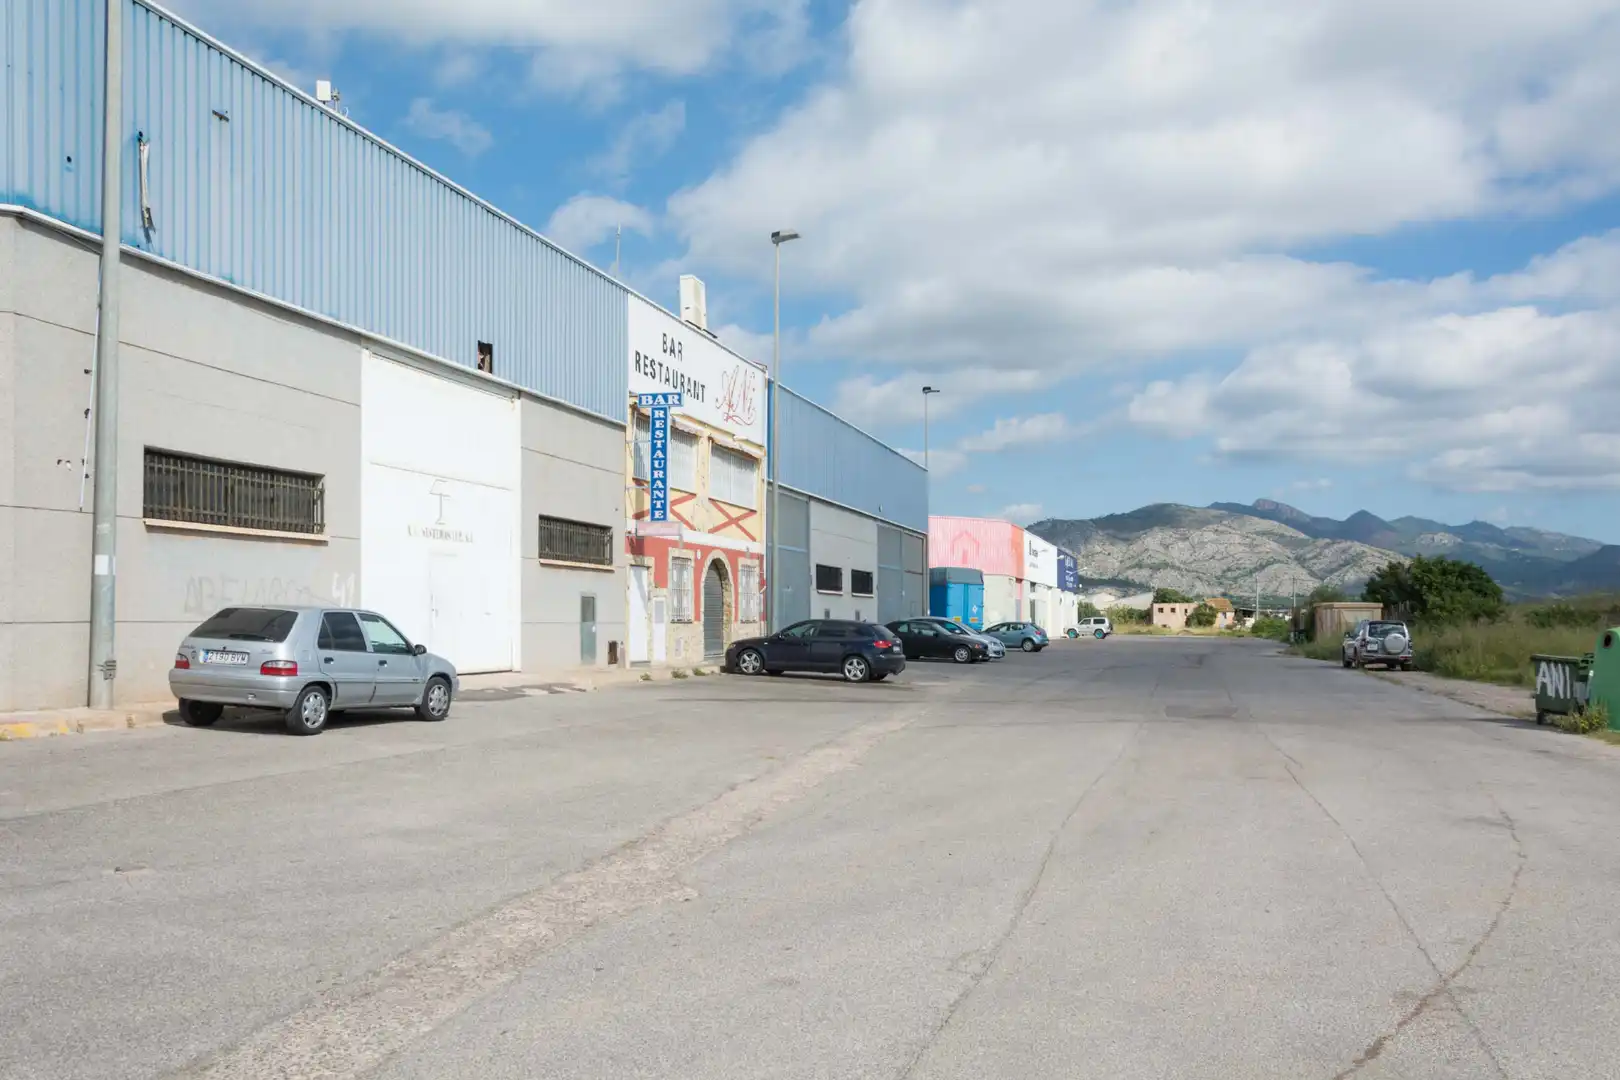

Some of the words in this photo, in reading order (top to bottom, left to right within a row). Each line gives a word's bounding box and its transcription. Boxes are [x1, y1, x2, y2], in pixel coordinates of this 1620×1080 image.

[662, 332, 684, 362] BAR
[634, 350, 706, 404] RESTAURANT
[639, 394, 682, 406] BAR
[652, 409, 666, 520] RESTAURANTE
[1536, 660, 1571, 700] ANI
